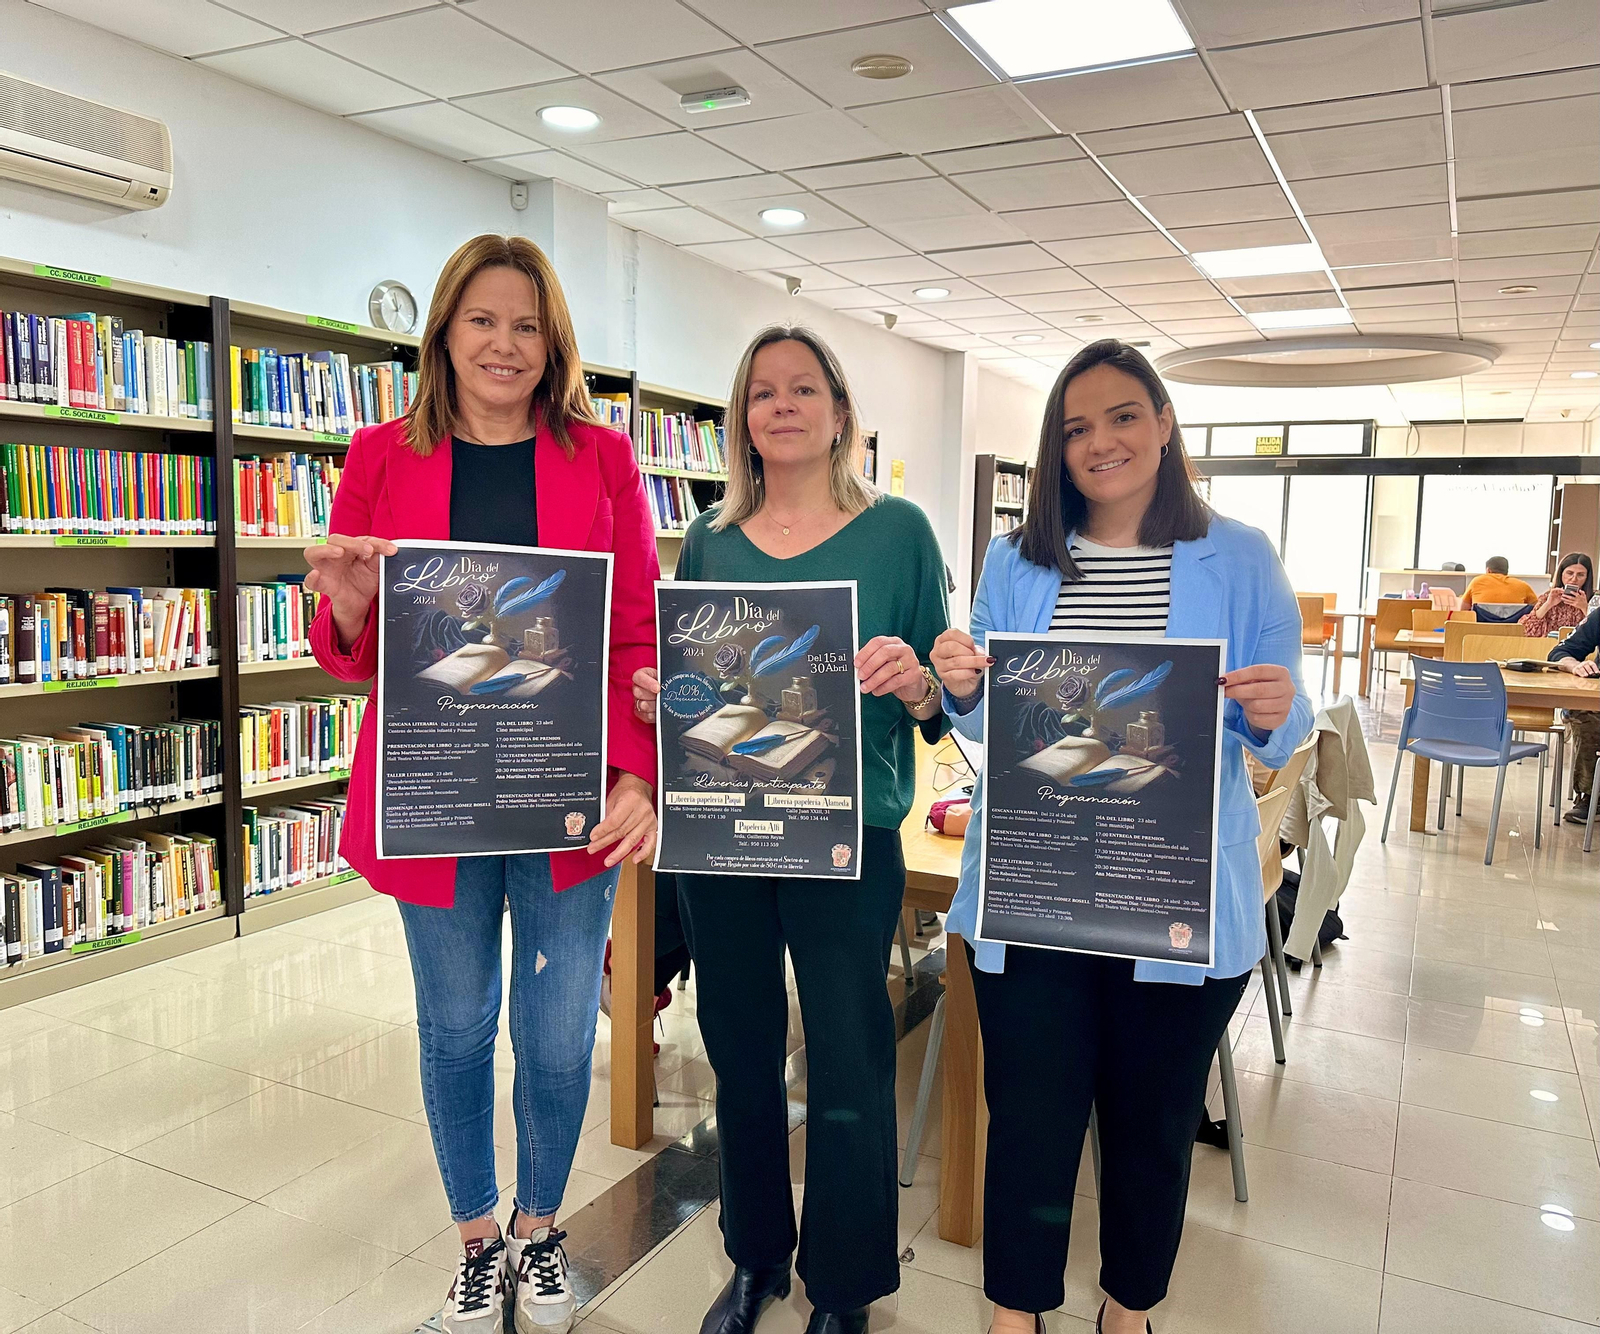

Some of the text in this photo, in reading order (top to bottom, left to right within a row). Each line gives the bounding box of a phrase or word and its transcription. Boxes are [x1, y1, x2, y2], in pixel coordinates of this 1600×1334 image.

[62, 272, 96, 283] SOCIALES
[326, 321, 349, 330] SOCIALES
[72, 411, 106, 420] SOCIALES
[461, 556, 499, 574] Día del
[393, 556, 496, 593] Libro
[412, 595, 437, 605] 2024
[734, 596, 780, 621] Día del
[668, 603, 772, 645] Libro
[682, 647, 705, 657] 2024
[1062, 649, 1100, 665] Día del
[823, 653, 836, 663] 15
[838, 654, 846, 662] al
[996, 649, 1097, 684] Libro
[66, 680, 98, 689] RELIGIÓN
[678, 684, 700, 696] 10%
[1014, 687, 1037, 696] 2024
[437, 695, 538, 716] Programación
[693, 774, 827, 794] Librerías participantes
[671, 794, 695, 803] Librería
[725, 795, 741, 805] Paqui
[767, 796, 792, 805] Librería
[823, 798, 849, 807] Alameda
[1038, 785, 1140, 807] Programación
[78, 817, 109, 830] RELIGIÓN
[739, 822, 766, 832] Papelería
[92, 938, 122, 948] RELIGIÓN
